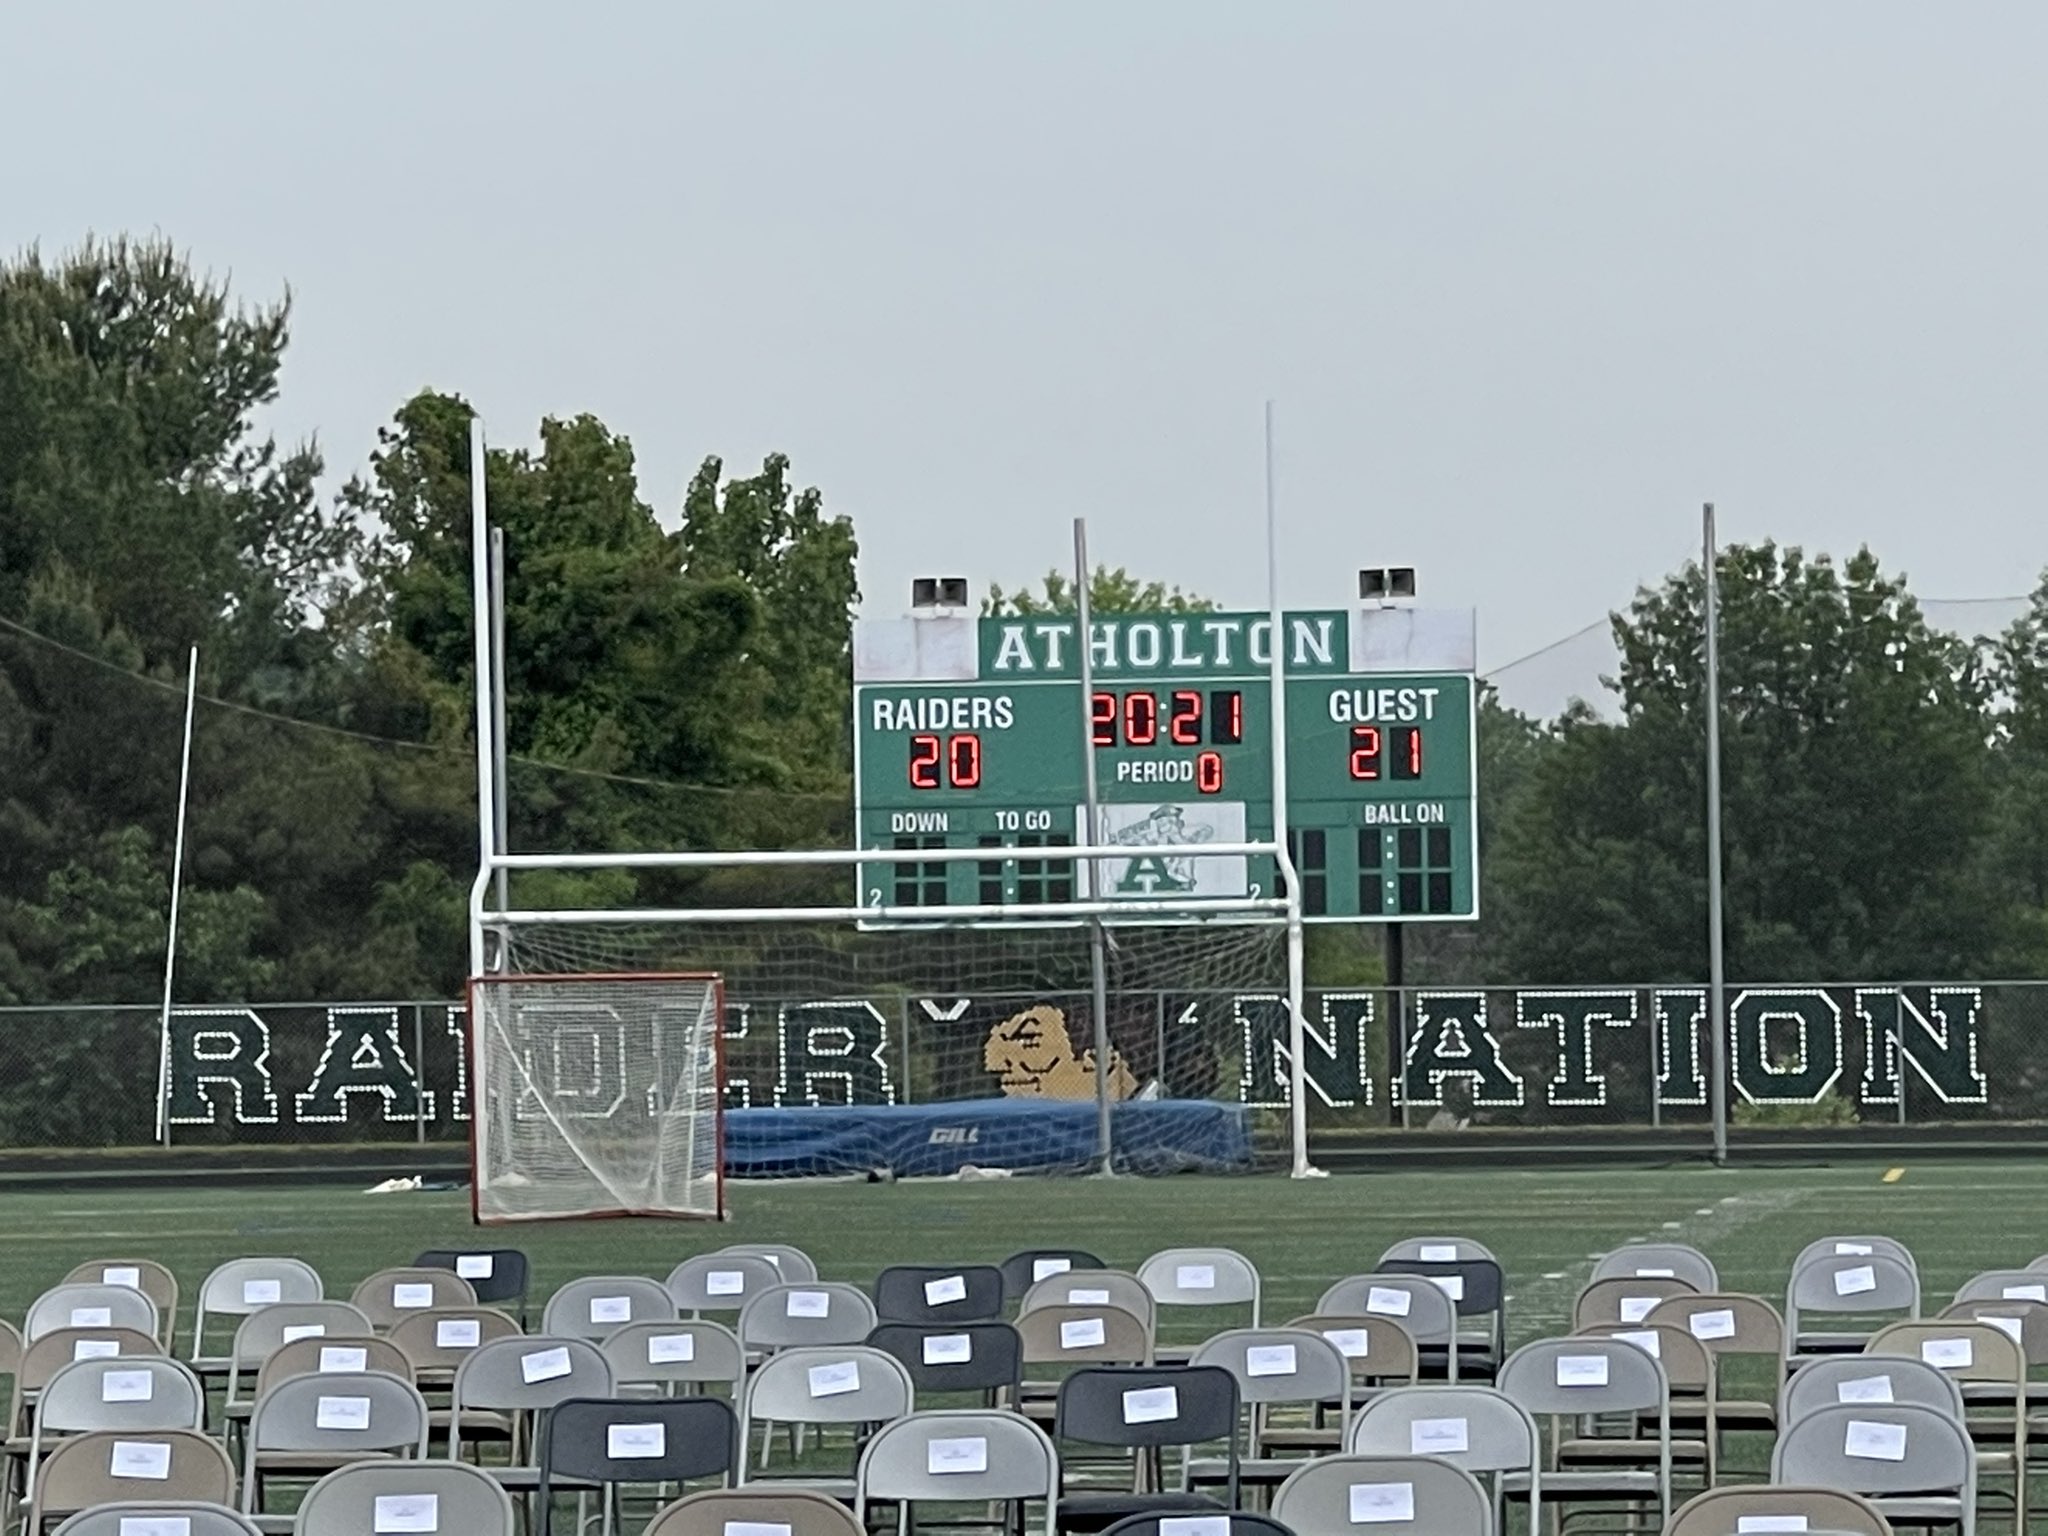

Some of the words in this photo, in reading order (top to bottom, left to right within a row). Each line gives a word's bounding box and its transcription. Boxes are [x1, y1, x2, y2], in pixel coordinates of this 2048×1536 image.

[994, 620, 1334, 669] ATHOLTON
[873, 696, 1014, 730] RAIDERS
[1090, 691, 1243, 745] 20:21
[1329, 688, 1440, 722] GUEST
[911, 734, 981, 788] 20
[1116, 760, 1194, 783] PERIOD
[1351, 727, 1421, 779] 21
[1197, 751, 1223, 794] 0
[891, 813, 948, 832] DOWN
[994, 811, 1019, 831] TO
[1025, 810, 1051, 831] GO
[1364, 804, 1412, 824] BALL
[1416, 803, 1444, 823] ON
[1234, 988, 1987, 1109] NATION
